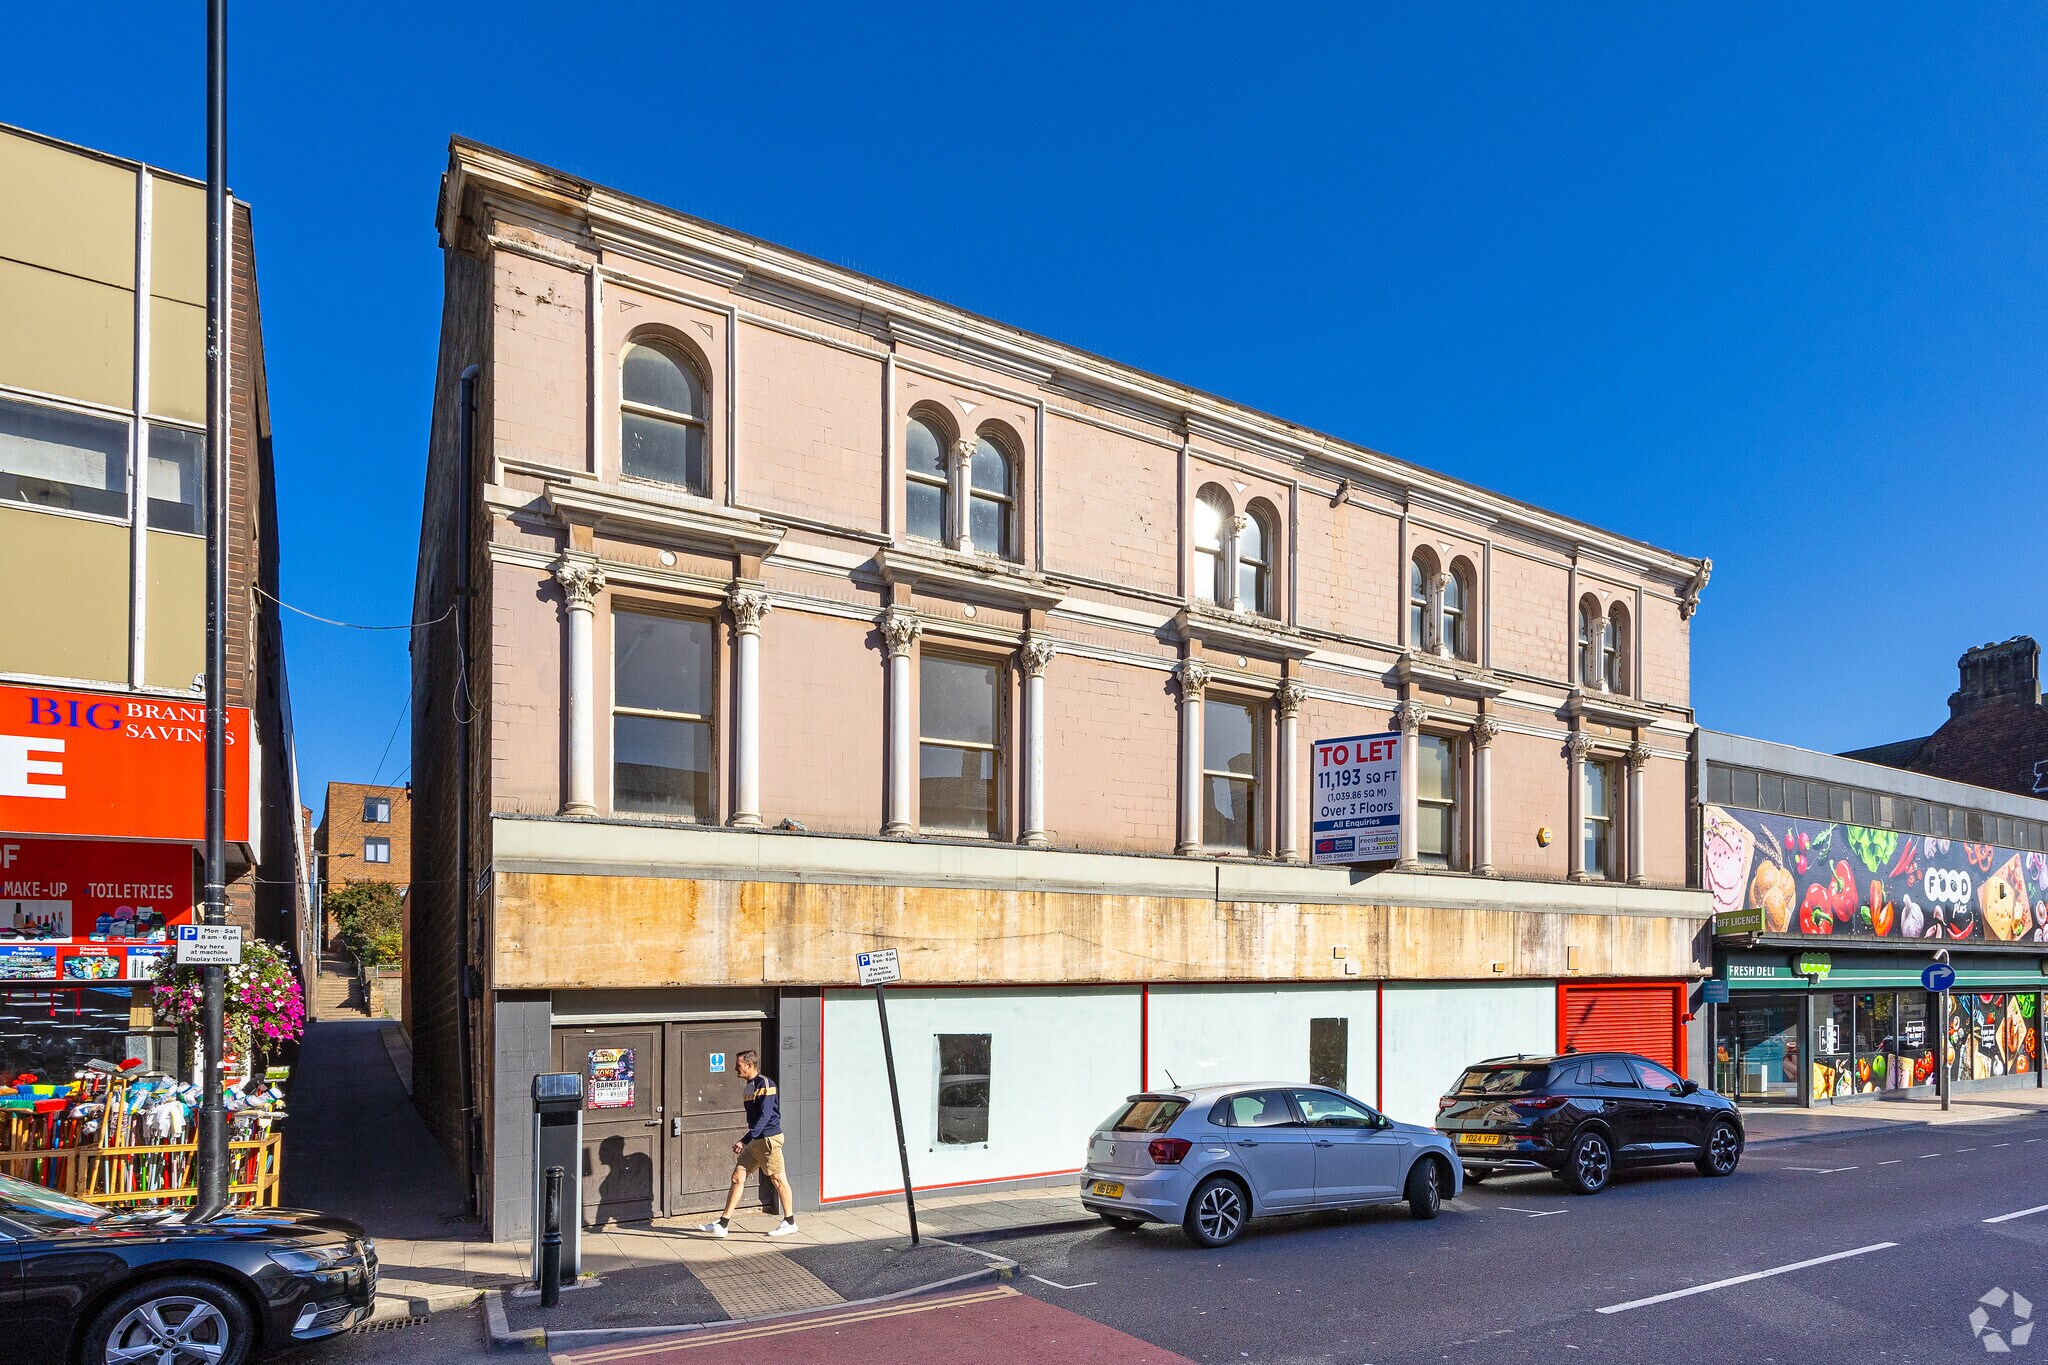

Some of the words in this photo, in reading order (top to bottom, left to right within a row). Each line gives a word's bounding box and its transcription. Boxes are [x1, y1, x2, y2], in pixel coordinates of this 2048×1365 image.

[26, 696, 125, 731] BIG
[126, 724, 235, 746] SAVINS
[1319, 744, 1349, 767] TO
[1356, 739, 1397, 763] LET
[1318, 768, 1361, 791] 11,193
[1366, 772, 1381, 784] SQ
[1384, 770, 1398, 782] FT
[1327, 790, 1362, 802] (1,039.86
[1363, 789, 1375, 798] SQ
[1377, 788, 1387, 797] M)
[1321, 806, 1346, 817] Over
[1349, 803, 1356, 815] 3
[1359, 802, 1394, 814] Floors
[1333, 821, 1344, 829] All
[1345, 818, 1380, 828] Enquiries
[1360, 836, 1397, 844] reesdenton
[4, 881, 68, 897] MAKE-UP
[88, 882, 174, 899] TOILETRIES
[1929, 875, 1968, 896] FOOD
[1953, 901, 1967, 918] plus
[1717, 918, 1730, 928] OFF
[1731, 914, 1760, 926] LICENCE
[184, 928, 196, 939] P
[861, 956, 869, 965] P
[1729, 965, 1755, 976] FRESH
[1756, 966, 1775, 977] DELI
[595, 1068, 614, 1078] KONG
[596, 1080, 627, 1089] BARNSLEY
[1483, 1135, 1498, 1143] VFF
